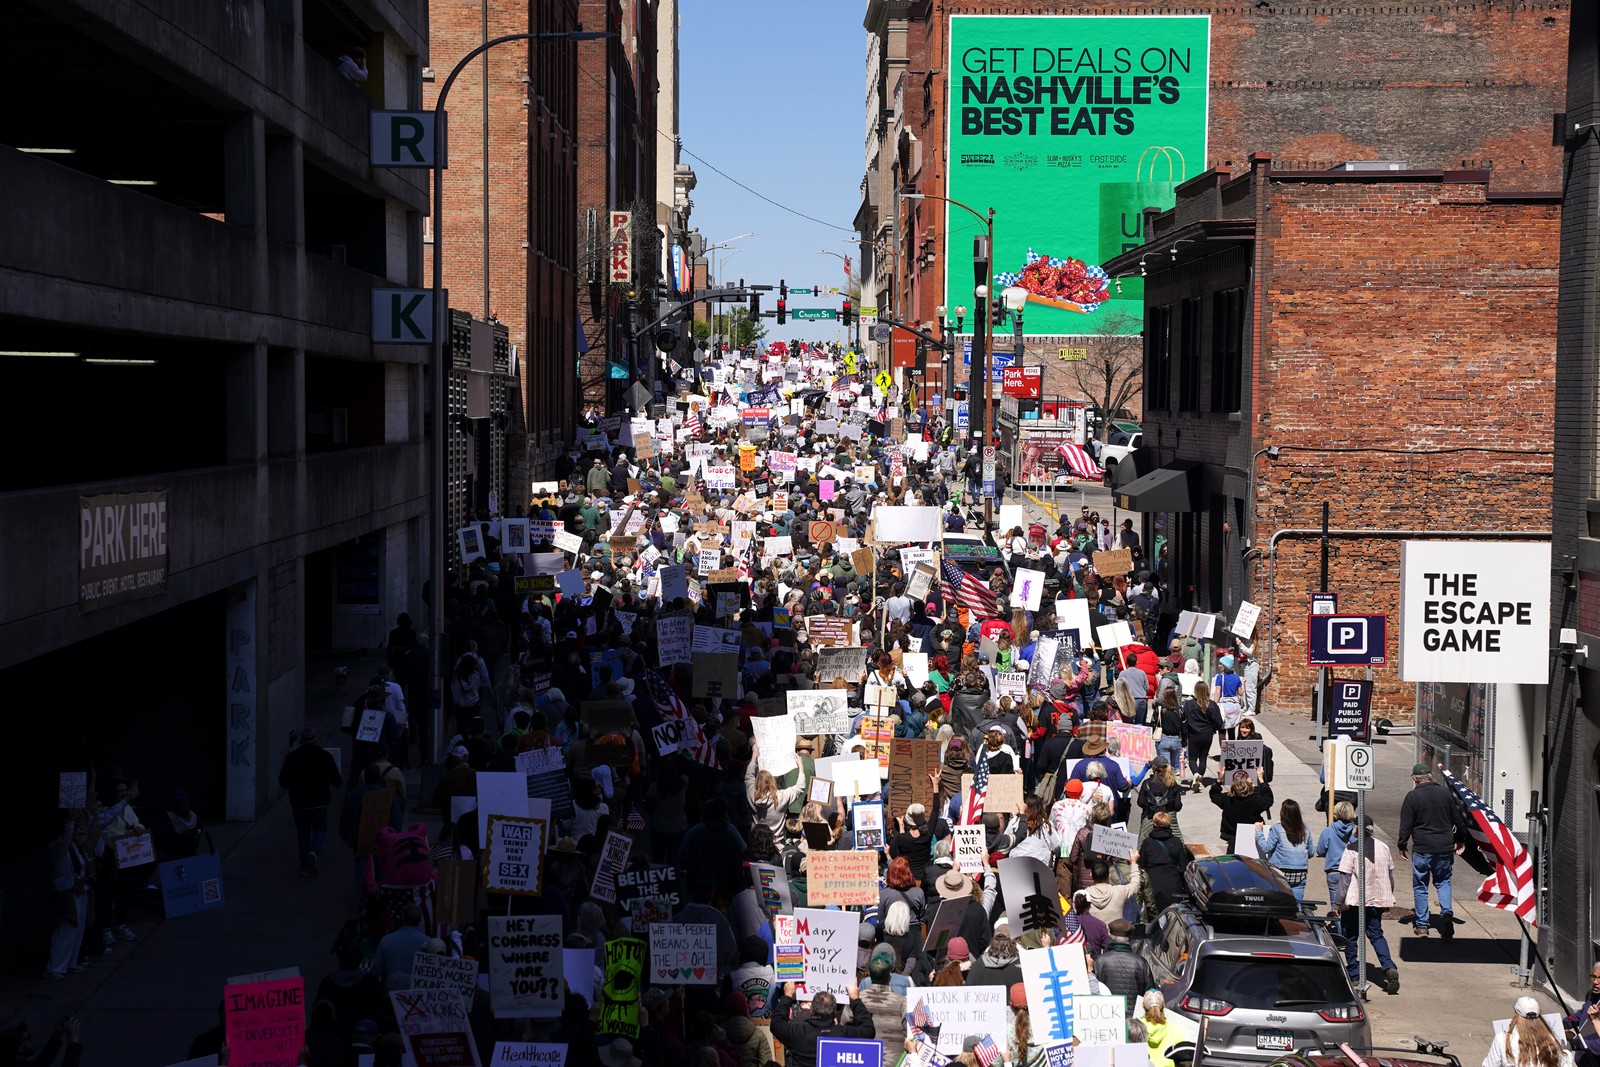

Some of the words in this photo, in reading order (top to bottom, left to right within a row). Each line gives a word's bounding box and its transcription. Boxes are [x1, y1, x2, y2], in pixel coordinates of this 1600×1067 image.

[962, 47, 1025, 74] GET
[1033, 47, 1131, 74] DEALS
[1141, 47, 1190, 74] ON
[962, 75, 1180, 105] NASHVILLE'S
[962, 107, 1044, 136] BEST
[1051, 107, 1135, 136] EATS
[390, 116, 426, 162] R
[961, 154, 995, 164] SWEEZA
[1110, 155, 1127, 163] SIDE
[613, 214, 628, 270] PARK
[391, 295, 427, 339] K
[1004, 370, 1021, 378] Park
[1004, 379, 1024, 387] Here.
[81, 504, 126, 569] PARK
[130, 501, 167, 559] HERE
[516, 581, 529, 590] NO
[1424, 573, 1478, 596] THE
[1424, 601, 1532, 625] ESCAPE
[1340, 627, 1355, 645] P
[1423, 629, 1501, 652] GAME
[230, 629, 250, 767] PARK
[1349, 688, 1356, 696] P
[1226, 747, 1258, 758] BOY
[1225, 758, 1260, 771] BYE!
[503, 826, 532, 839] WAR
[1102, 829, 1112, 837] No
[1114, 832, 1132, 841] more
[962, 836, 978, 845] WE
[959, 846, 983, 855] SING
[1103, 847, 1122, 857] WAR
[501, 863, 529, 877] SEX
[617, 867, 677, 887] BELIEVE
[637, 884, 659, 896] THE
[506, 918, 536, 932] HEY
[651, 925, 664, 935] WE
[668, 925, 681, 935] THE
[685, 926, 714, 935] PEOPLE
[796, 917, 835, 942] Many
[491, 934, 560, 948] CONGRESS
[653, 939, 690, 949] MEANS
[692, 939, 712, 949] ALL
[416, 954, 436, 965] THE
[438, 958, 473, 971] WORLD
[501, 952, 549, 964] WHERE
[652, 954, 671, 967] THE
[675, 952, 716, 966] PEOPLE
[414, 965, 443, 979] NEEDS
[444, 970, 474, 985] MORE
[515, 966, 543, 977] ARE
[413, 978, 445, 989] YOUNG
[510, 978, 559, 1000] YOU??
[229, 988, 302, 1012] IMAGINE
[427, 991, 449, 1003] NO
[926, 992, 958, 1004] HONK
[964, 992, 972, 1002] IF
[975, 992, 1000, 1003] YOU'RE
[430, 1001, 466, 1020] KINGS
[932, 1011, 950, 1022] NOT
[958, 1011, 966, 1022] IN
[972, 1010, 987, 1021] THE
[1079, 1004, 1121, 1020] LOCK
[1266, 1014, 1287, 1023] Jeep
[245, 1025, 299, 1041] DIVERSITY
[1082, 1028, 1118, 1042] THEM
[501, 1045, 561, 1062] Healthcare
[837, 1052, 864, 1064] HELL
[1049, 1047, 1064, 1056] HATE
[1050, 1053, 1063, 1062] NOT
